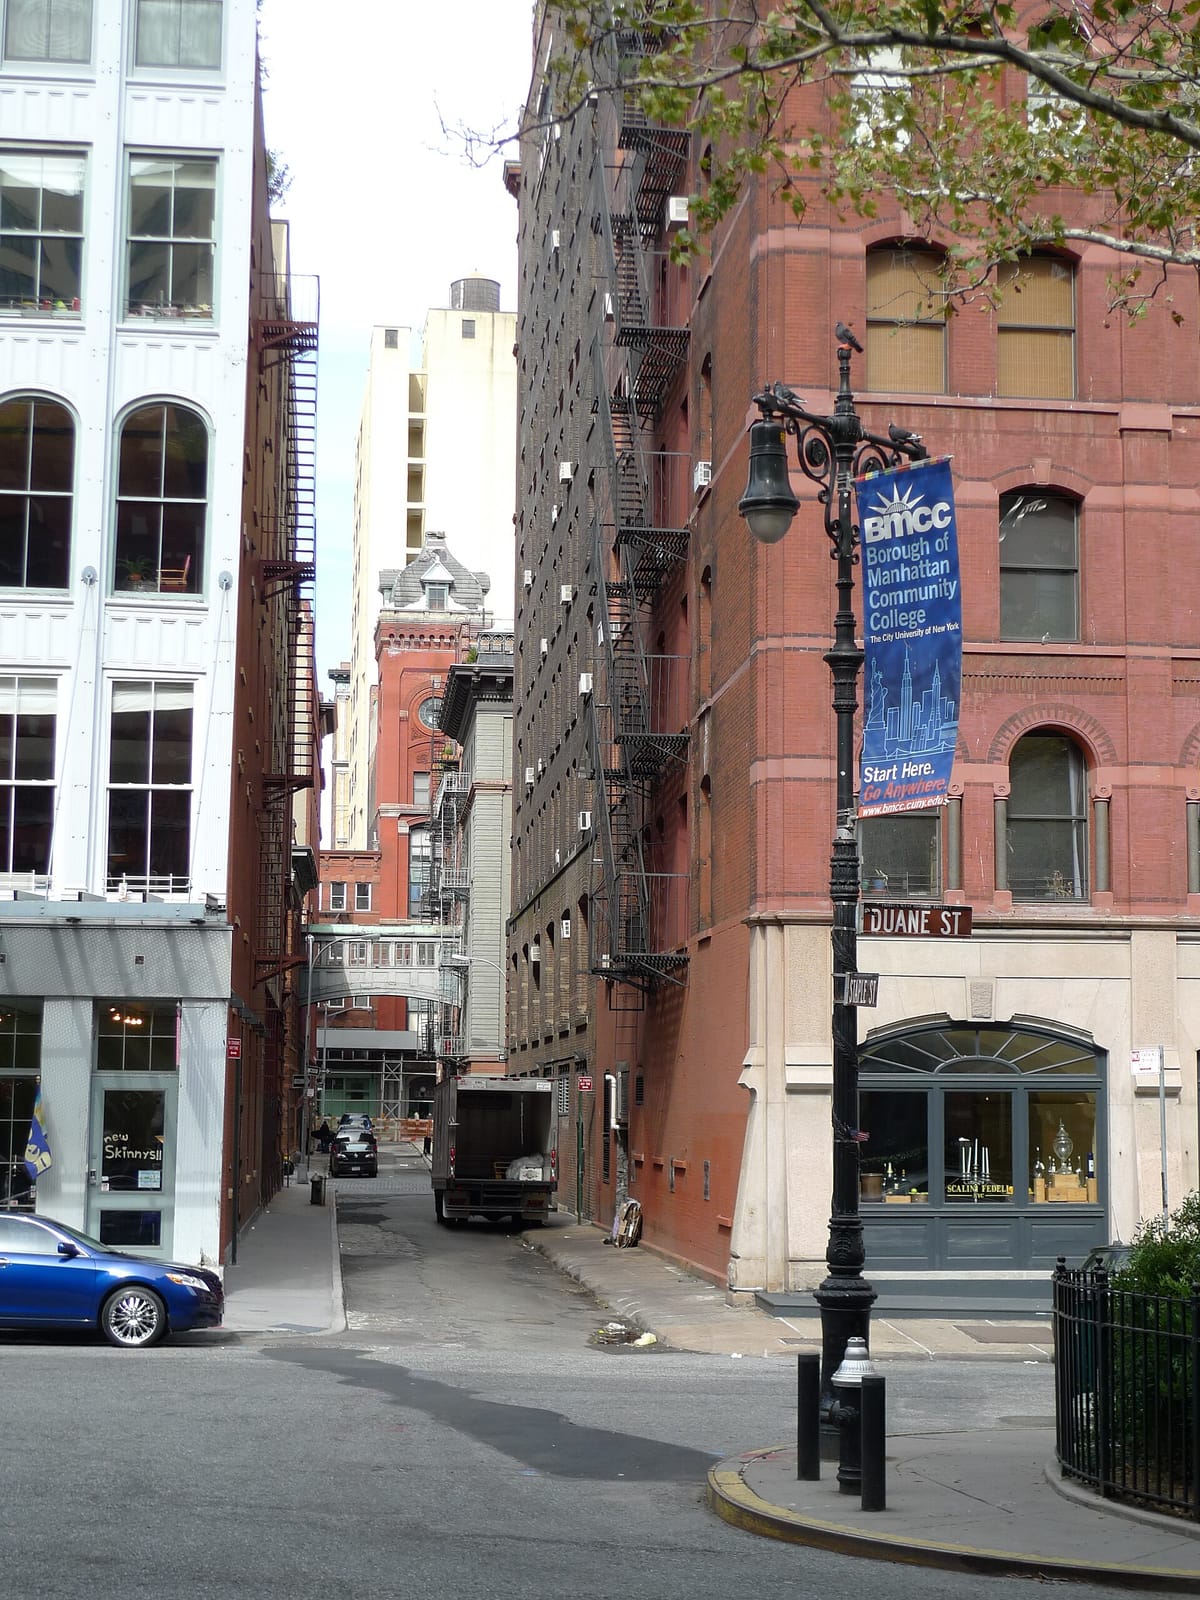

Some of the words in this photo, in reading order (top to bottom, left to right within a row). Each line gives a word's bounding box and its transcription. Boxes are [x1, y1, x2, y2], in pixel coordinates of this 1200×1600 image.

[866, 537, 930, 566] Borough
[935, 531, 949, 553] of
[867, 559, 950, 588] Manhattan
[869, 578, 957, 609] Community
[870, 608, 926, 631] College
[870, 634, 882, 644] The
[882, 633, 894, 642] City
[895, 627, 925, 640] University
[924, 626, 932, 635] of
[932, 624, 946, 633] New
[946, 622, 960, 631] York
[863, 764, 898, 783] Start
[901, 761, 935, 779] Here.
[863, 784, 881, 800] Go
[883, 777, 947, 799] Anywhere.
[862, 795, 944, 817] www.bmcc.cuny.edu
[870, 908, 931, 934] DUANE
[940, 910, 962, 935] ST
[849, 979, 868, 1004] STAPLE
[868, 979, 877, 1005] ST
[104, 1133, 129, 1143] new
[981, 1184, 1009, 1193] FEDELI
